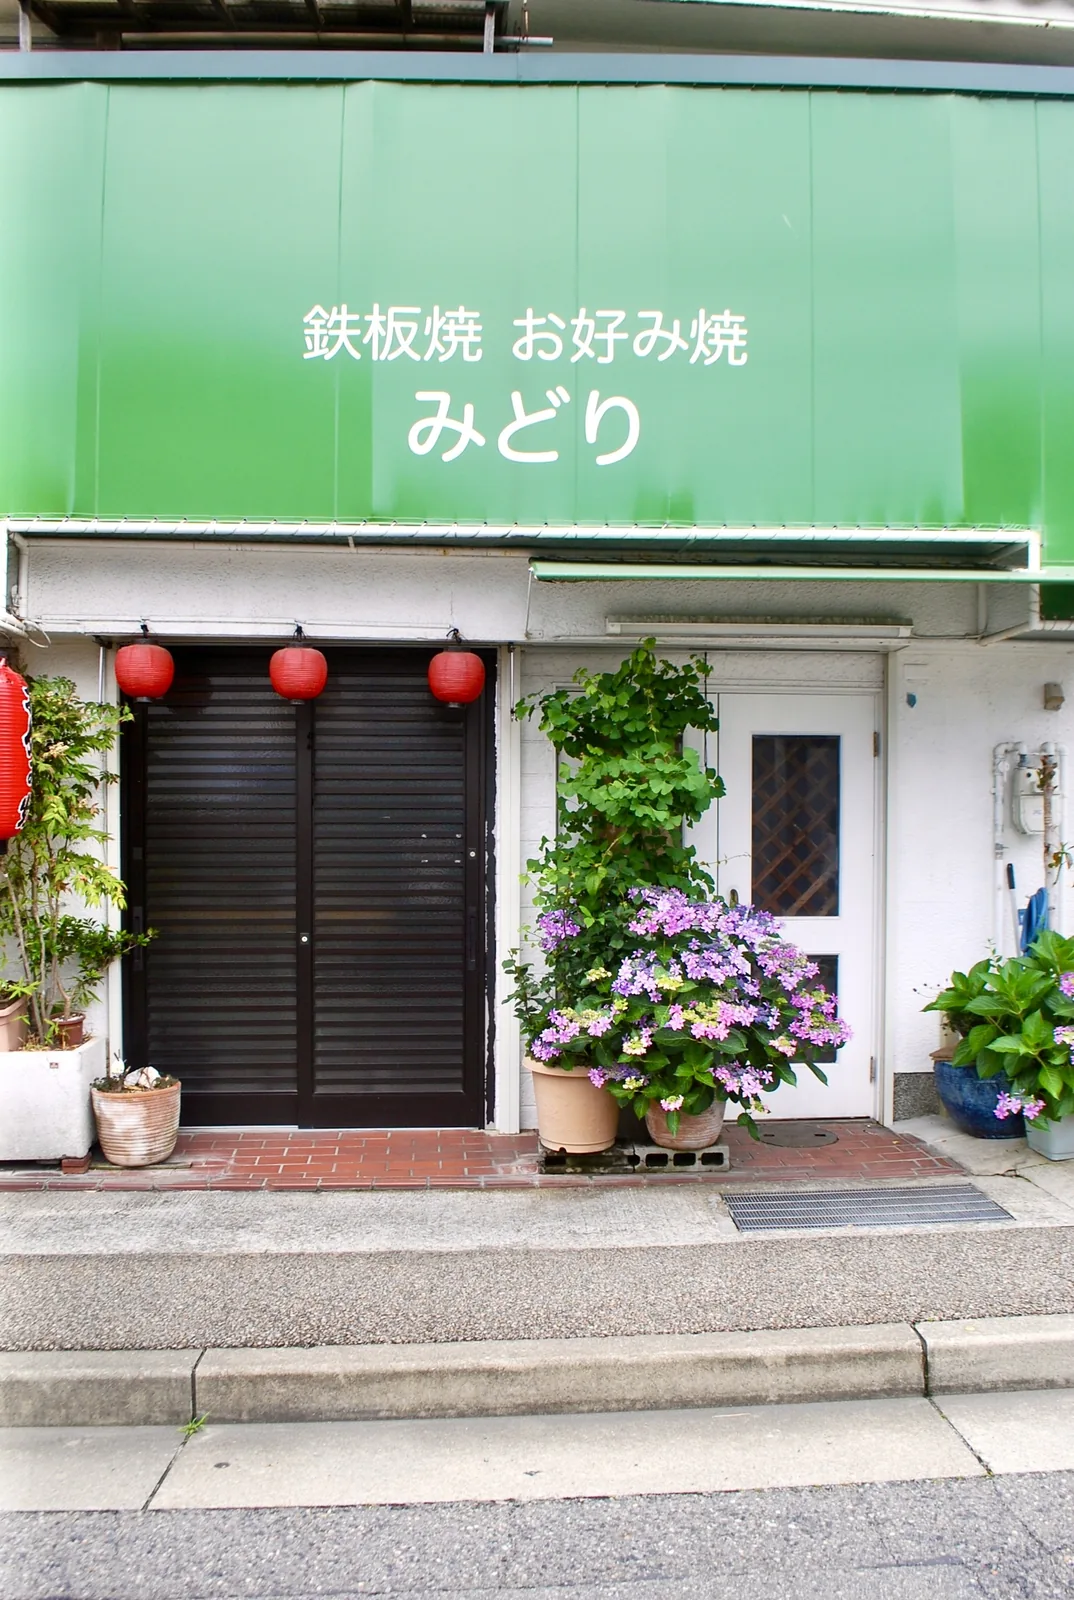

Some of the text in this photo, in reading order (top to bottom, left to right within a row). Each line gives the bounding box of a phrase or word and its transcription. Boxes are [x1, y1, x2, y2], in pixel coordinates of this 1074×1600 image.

[302, 303, 748, 366] 鉄板焼 お好み焼
[408, 386, 640, 466] みどり
